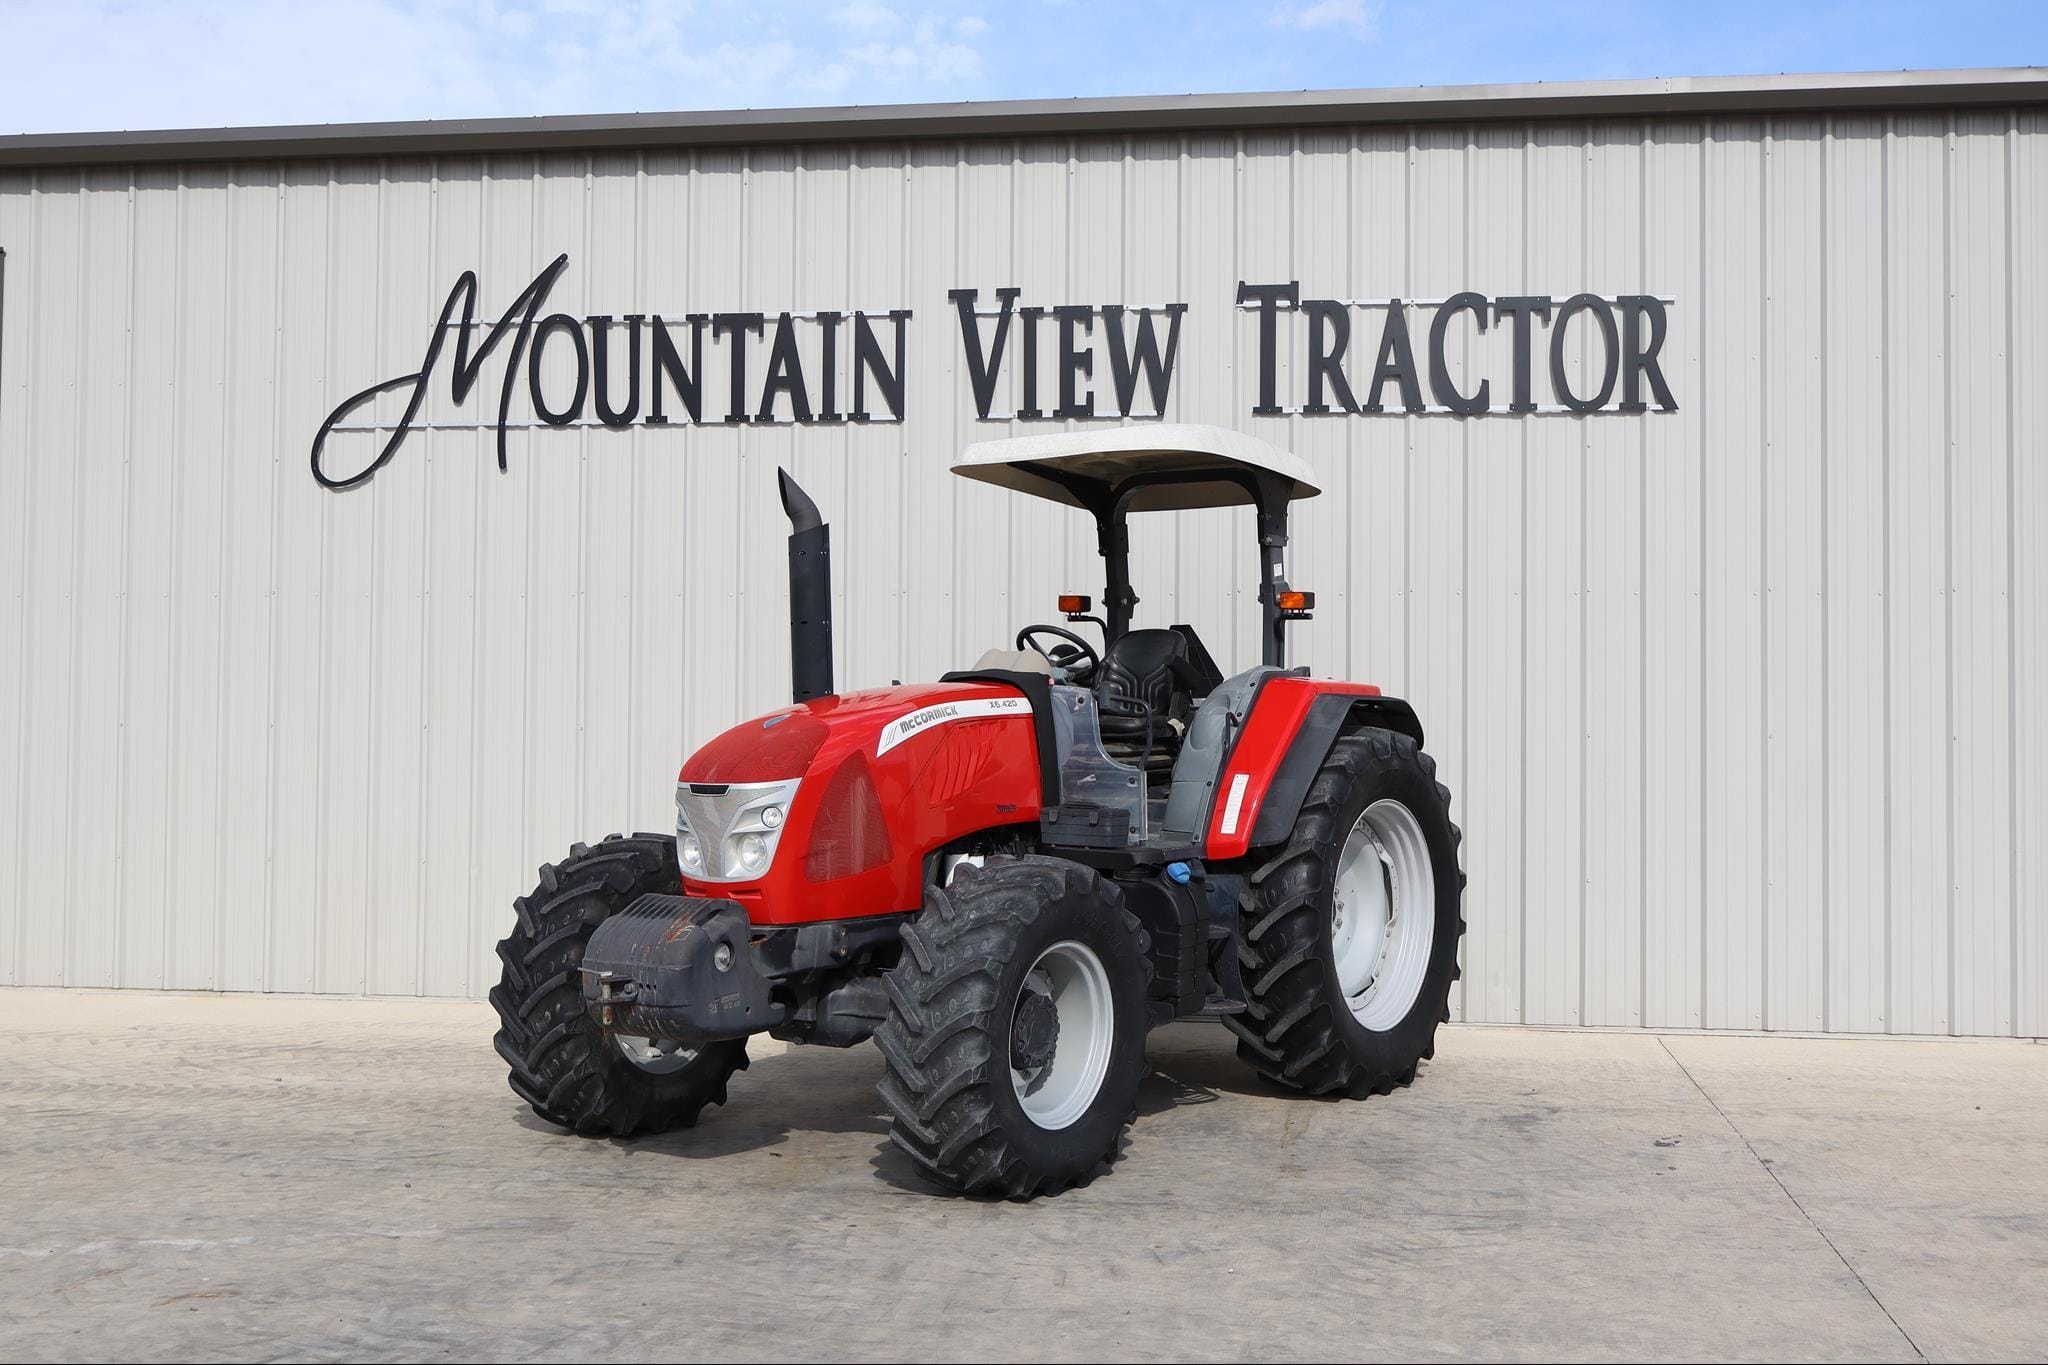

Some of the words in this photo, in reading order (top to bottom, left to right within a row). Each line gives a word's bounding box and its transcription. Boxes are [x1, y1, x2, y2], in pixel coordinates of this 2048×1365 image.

[311, 253, 912, 489] MOUNTAIN
[948, 288, 1188, 419] VIEW
[1237, 280, 1679, 415] TRACTOR
